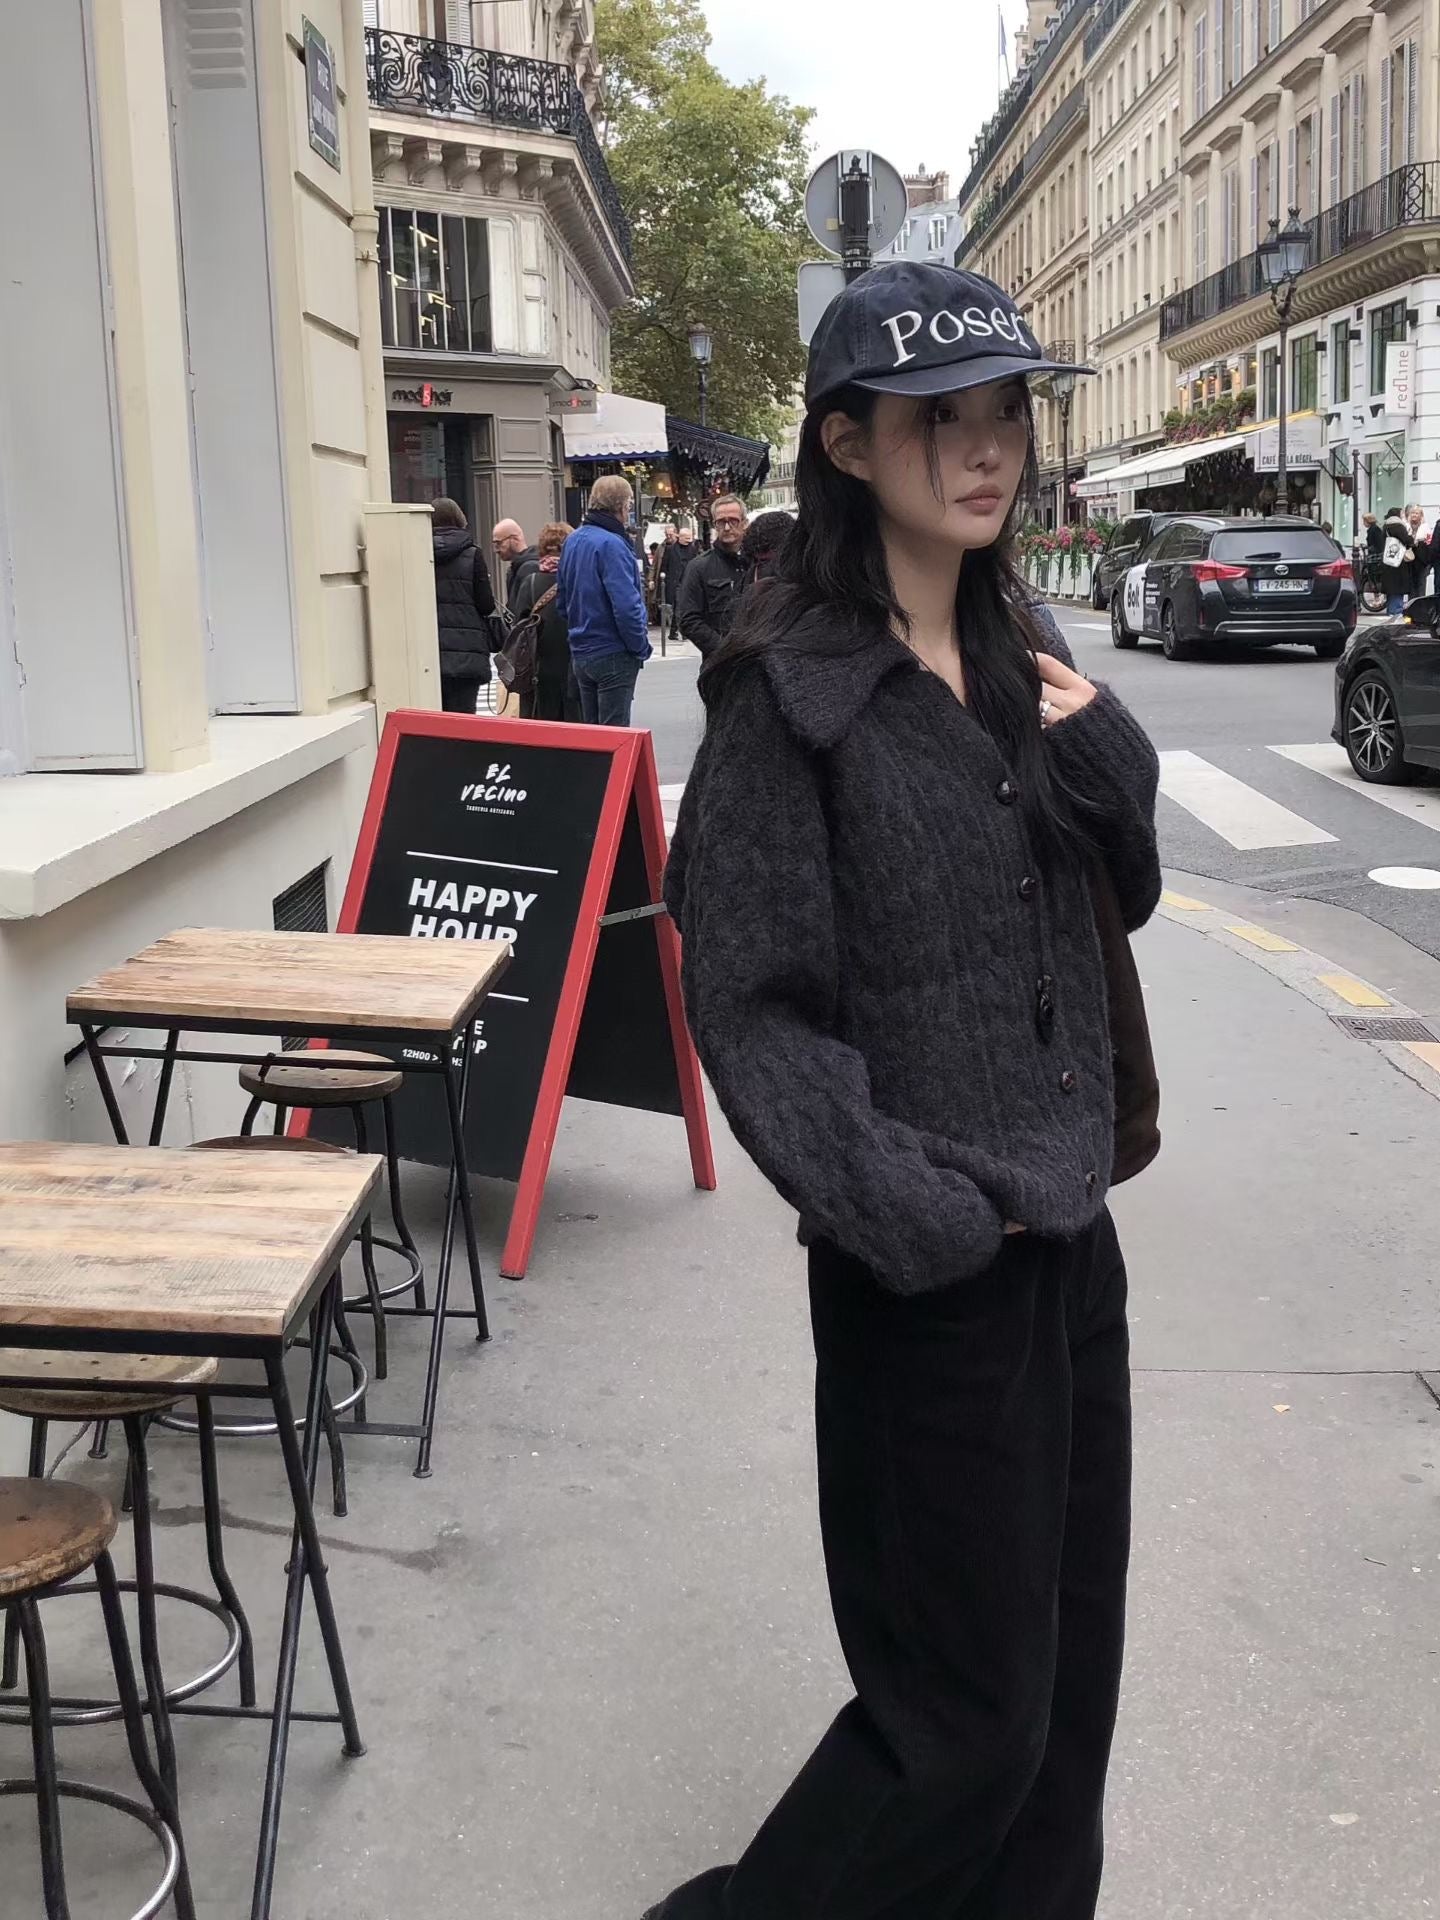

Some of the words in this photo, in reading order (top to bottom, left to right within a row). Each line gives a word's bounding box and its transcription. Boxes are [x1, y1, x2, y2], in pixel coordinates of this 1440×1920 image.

[880, 306, 1031, 368] Poser
[1127, 582, 1140, 608] Bolt
[486, 763, 511, 783] EL
[460, 784, 527, 803] VECINO
[408, 877, 538, 920] HAPPY
[402, 1048, 431, 1061] 12H00
